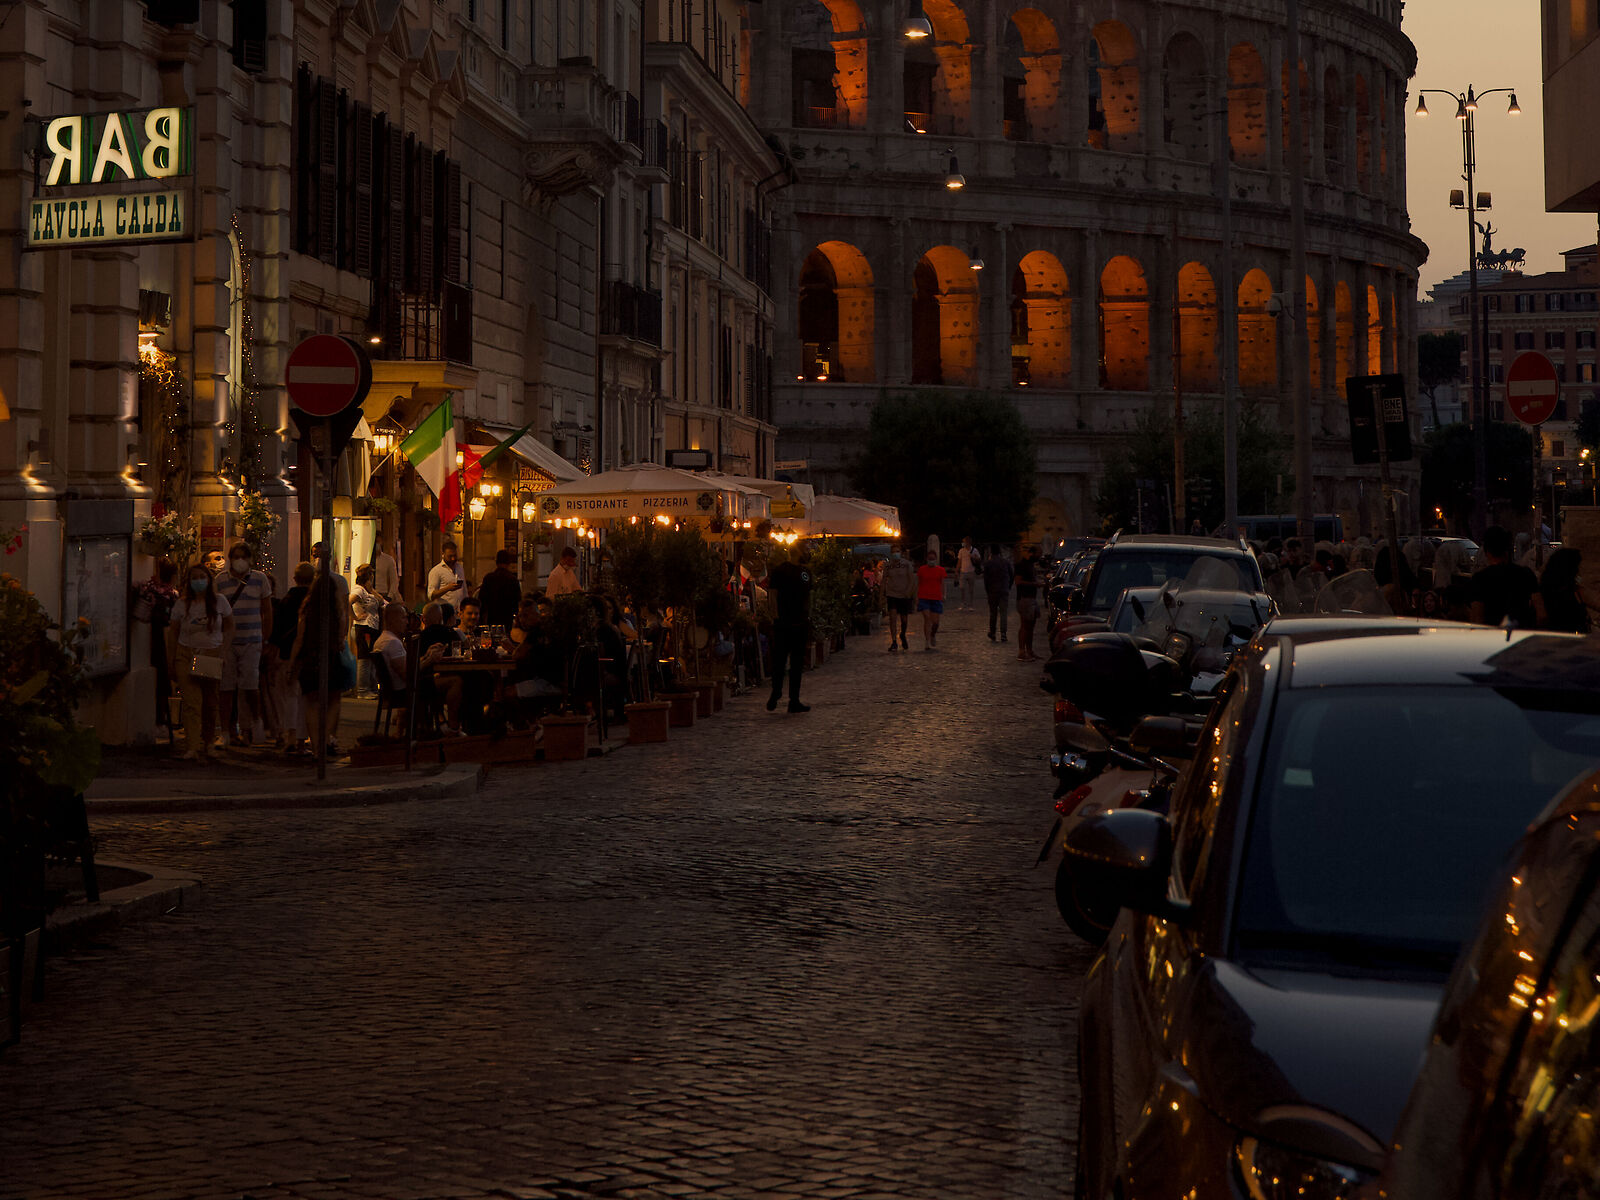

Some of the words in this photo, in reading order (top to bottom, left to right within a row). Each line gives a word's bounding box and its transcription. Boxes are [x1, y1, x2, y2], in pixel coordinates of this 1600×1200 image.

[33, 200, 105, 240] TAVOLA
[116, 194, 181, 235] CALDA
[566, 499, 629, 510] RISTORANTE
[643, 497, 689, 508] PIZZERIA
